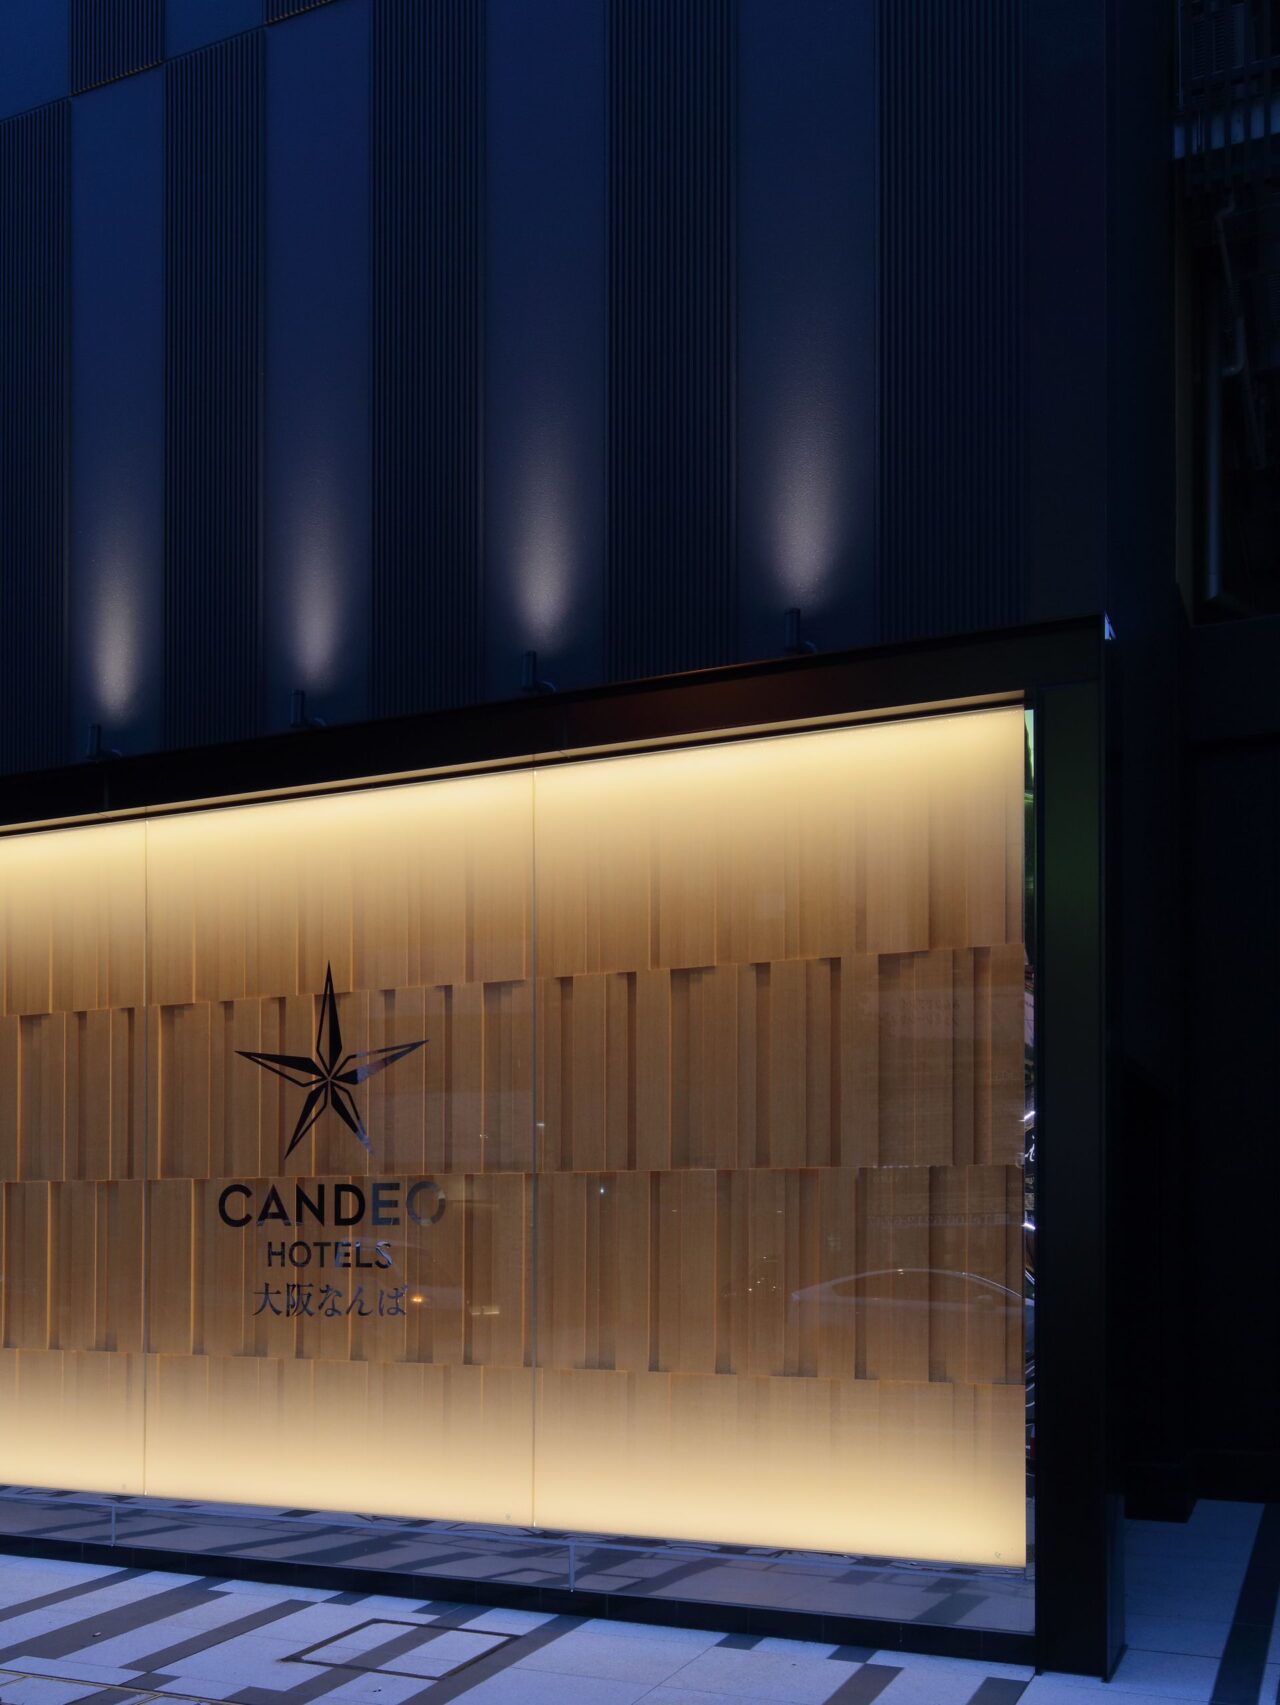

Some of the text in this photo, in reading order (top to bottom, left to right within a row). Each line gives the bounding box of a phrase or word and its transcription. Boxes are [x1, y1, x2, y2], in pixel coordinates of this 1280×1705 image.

[218, 1180, 447, 1228] CANDEO
[266, 1240, 394, 1270] HOTELS
[252, 1282, 408, 1318] 大阪なんば
